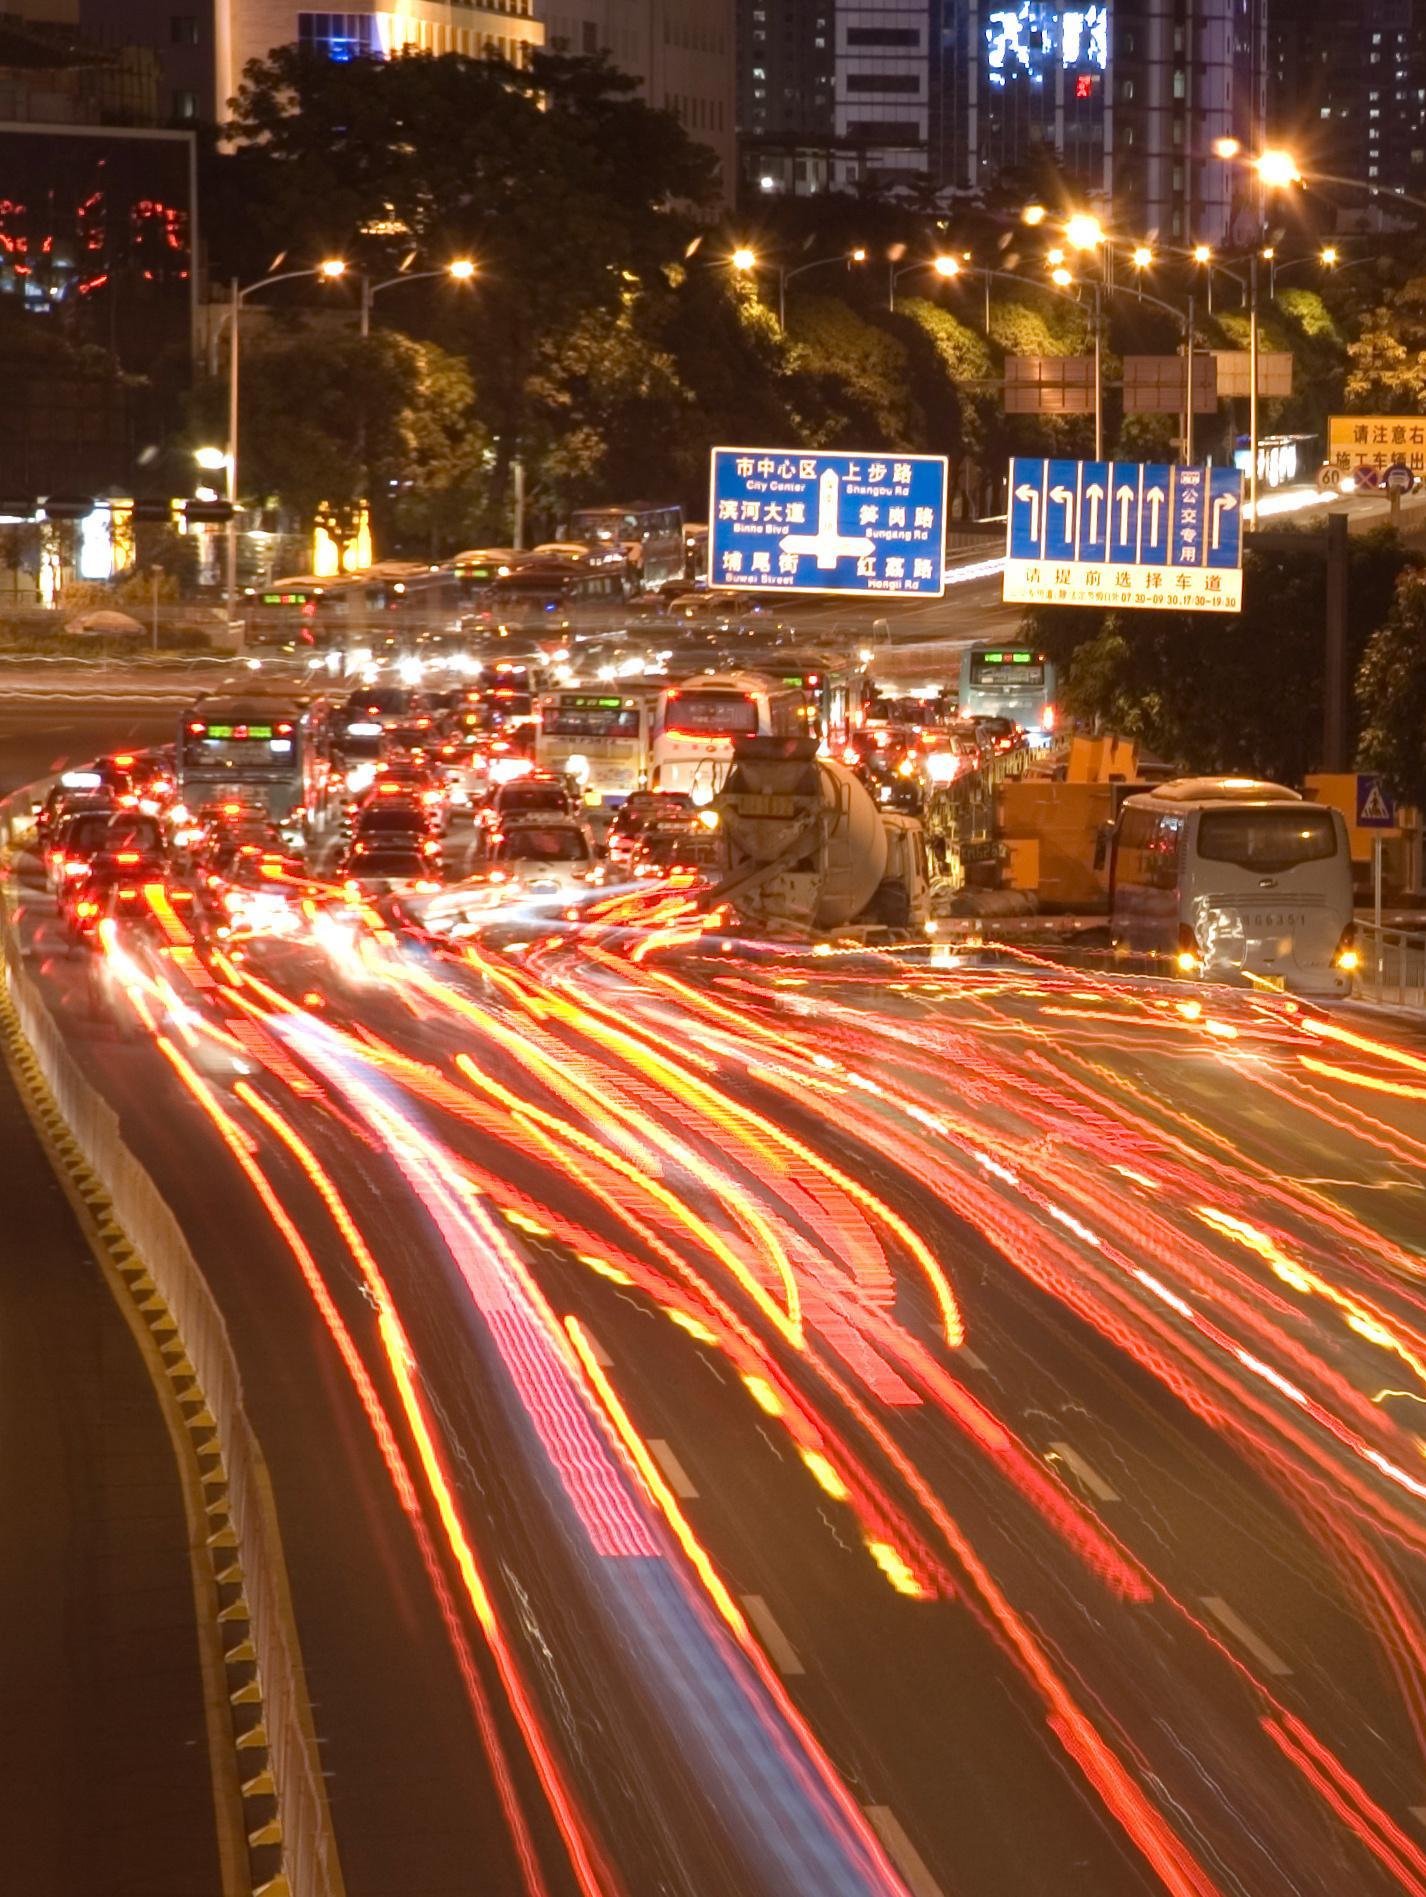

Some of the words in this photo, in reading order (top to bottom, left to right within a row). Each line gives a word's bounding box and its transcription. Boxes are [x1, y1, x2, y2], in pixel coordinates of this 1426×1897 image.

[735, 457, 818, 480] 市中心区
[842, 461, 913, 484] 上步路
[1322, 470, 1340, 485] 60
[746, 480, 767, 493] City
[769, 481, 806, 493] Center
[895, 486, 910, 496] Rd
[719, 499, 806, 523] 滨河大道
[766, 524, 789, 534] Blvd
[1179, 488, 1199, 563] 公交专用
[865, 528, 912, 541] Sungang
[913, 530, 928, 541] Rd
[761, 574, 794, 585] Street
[904, 580, 920, 590] Rd
[1025, 567, 1222, 592] 请提前选择车道
